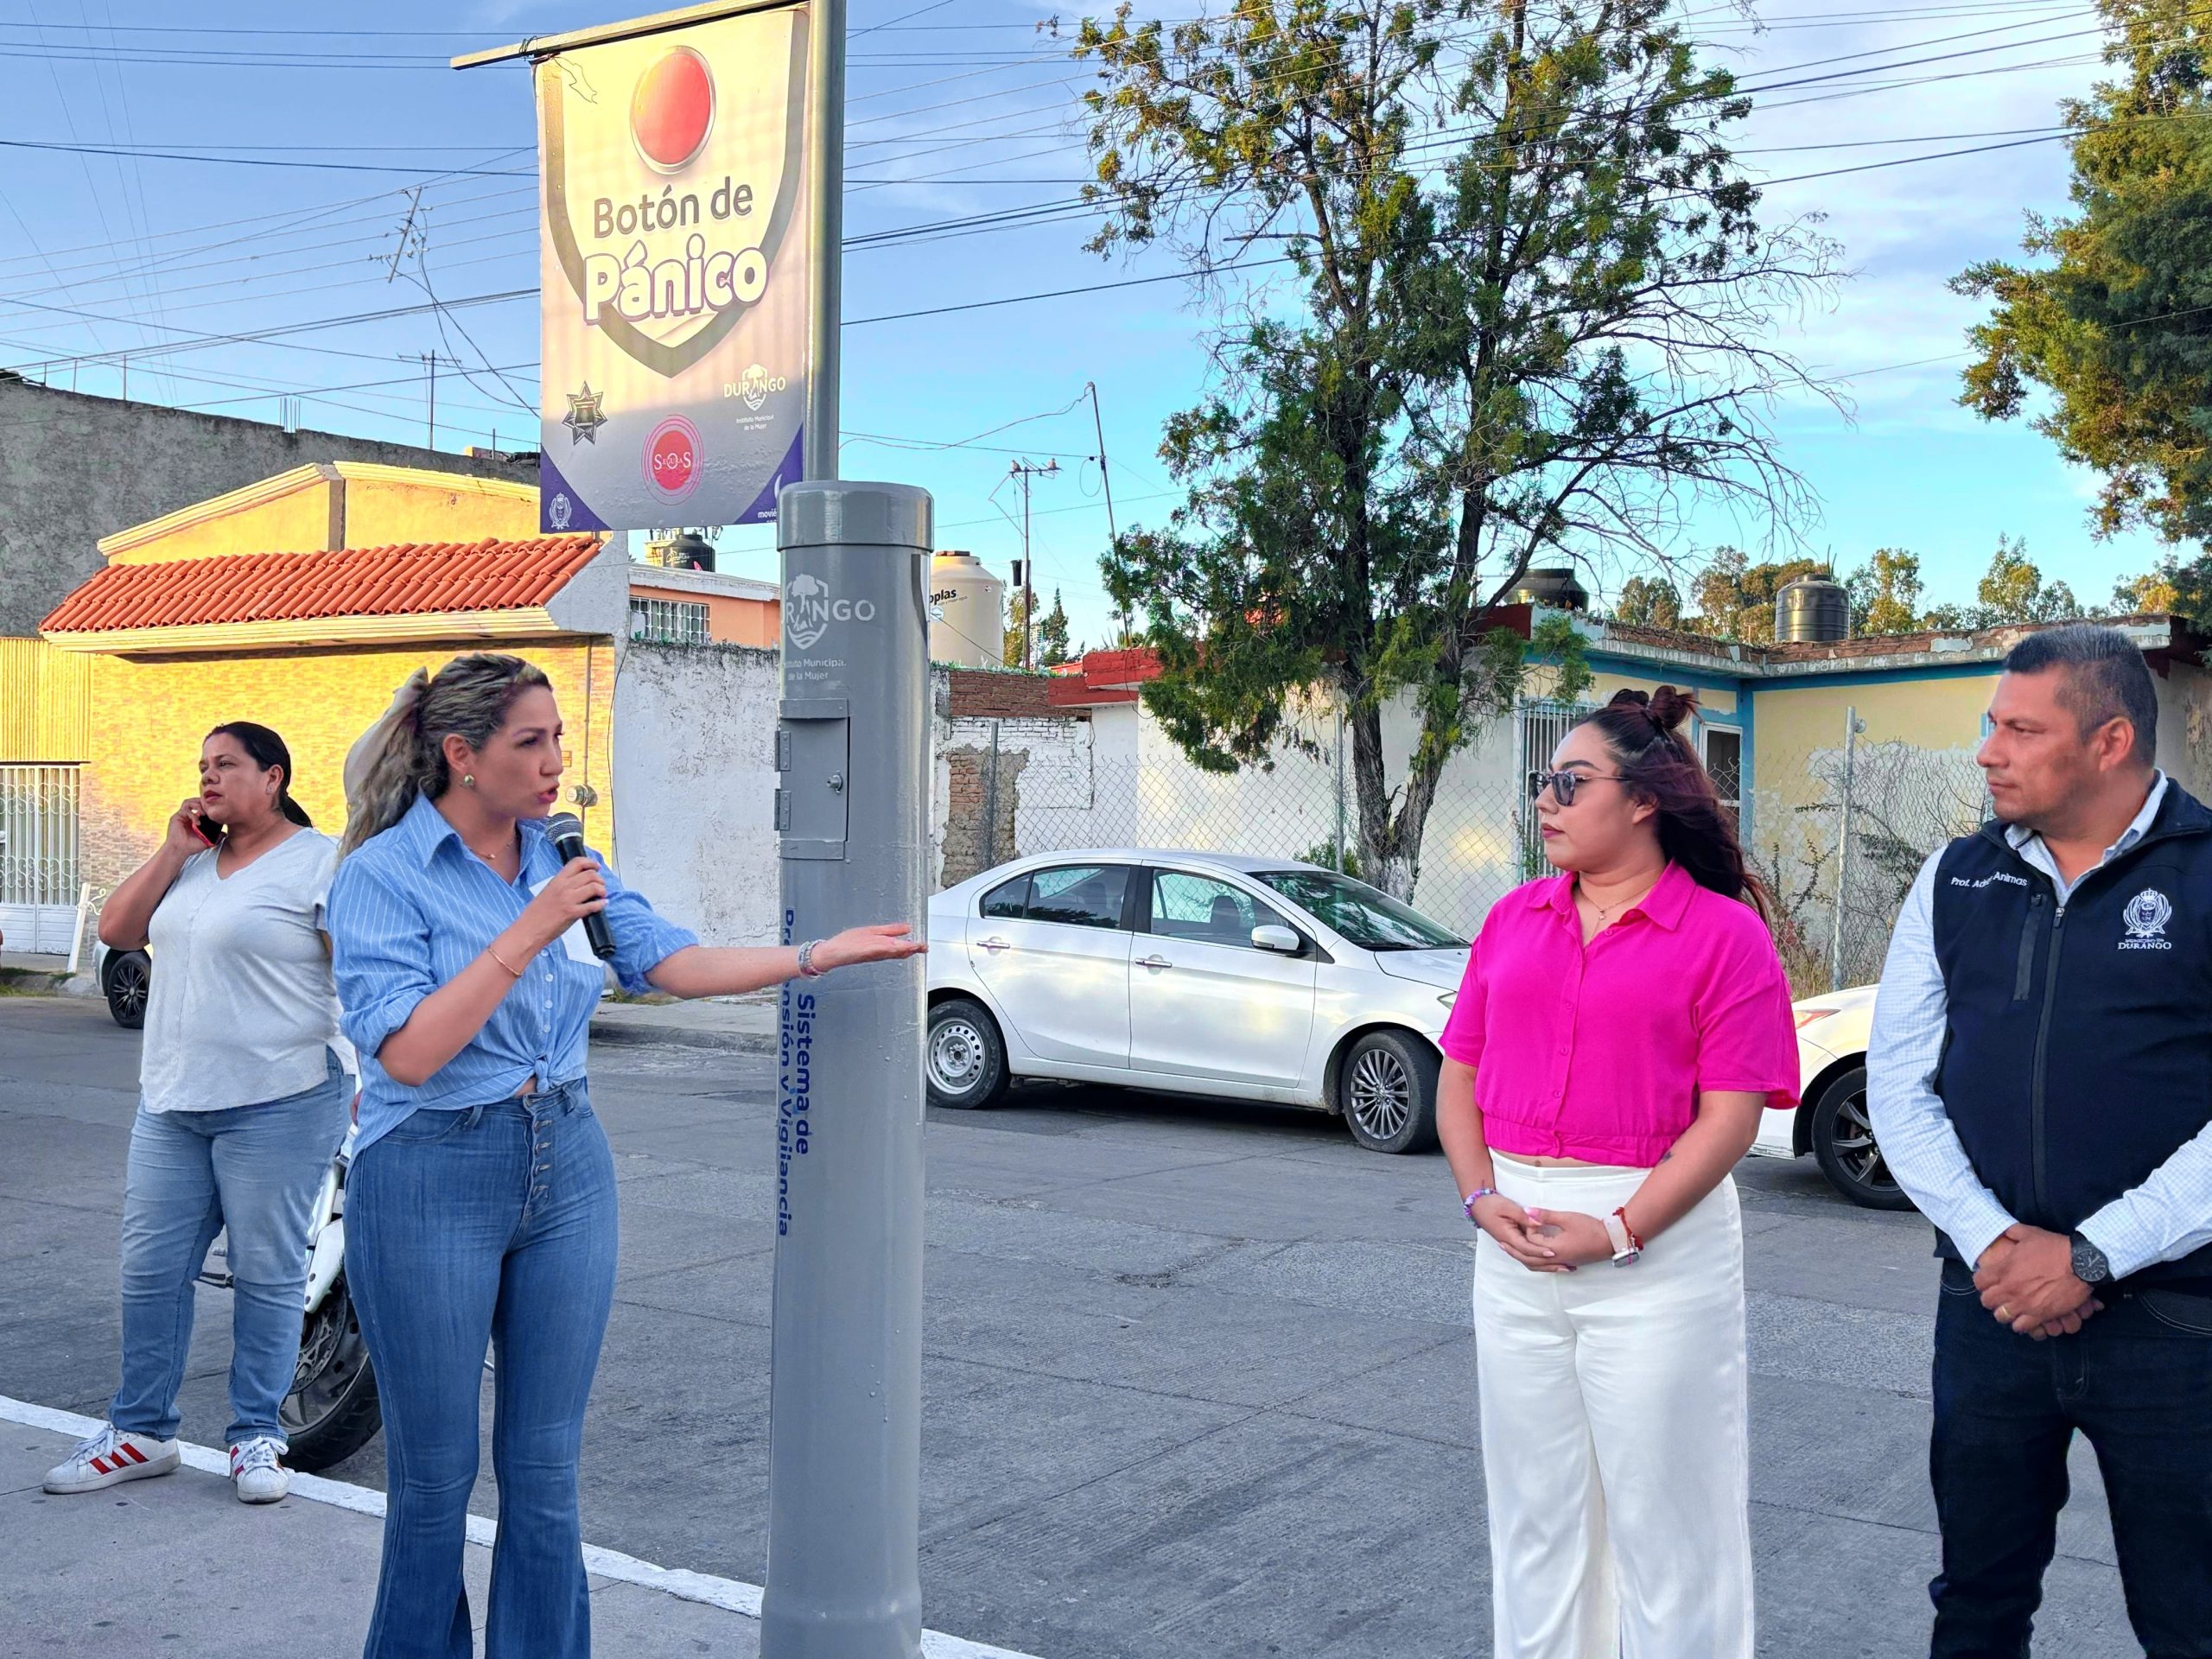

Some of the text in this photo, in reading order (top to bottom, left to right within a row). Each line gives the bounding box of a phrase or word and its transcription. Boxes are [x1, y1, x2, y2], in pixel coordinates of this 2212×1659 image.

[594, 175, 753, 238] Botón de
[583, 233, 770, 326] Pánico
[723, 377, 786, 397] DURANGO
[803, 658, 847, 668] Municipa
[804, 671, 829, 681] Mujer
[1950, 877, 1971, 887] Prof.
[1993, 871, 2028, 887] Animas
[796, 993, 817, 1154] Sistema de
